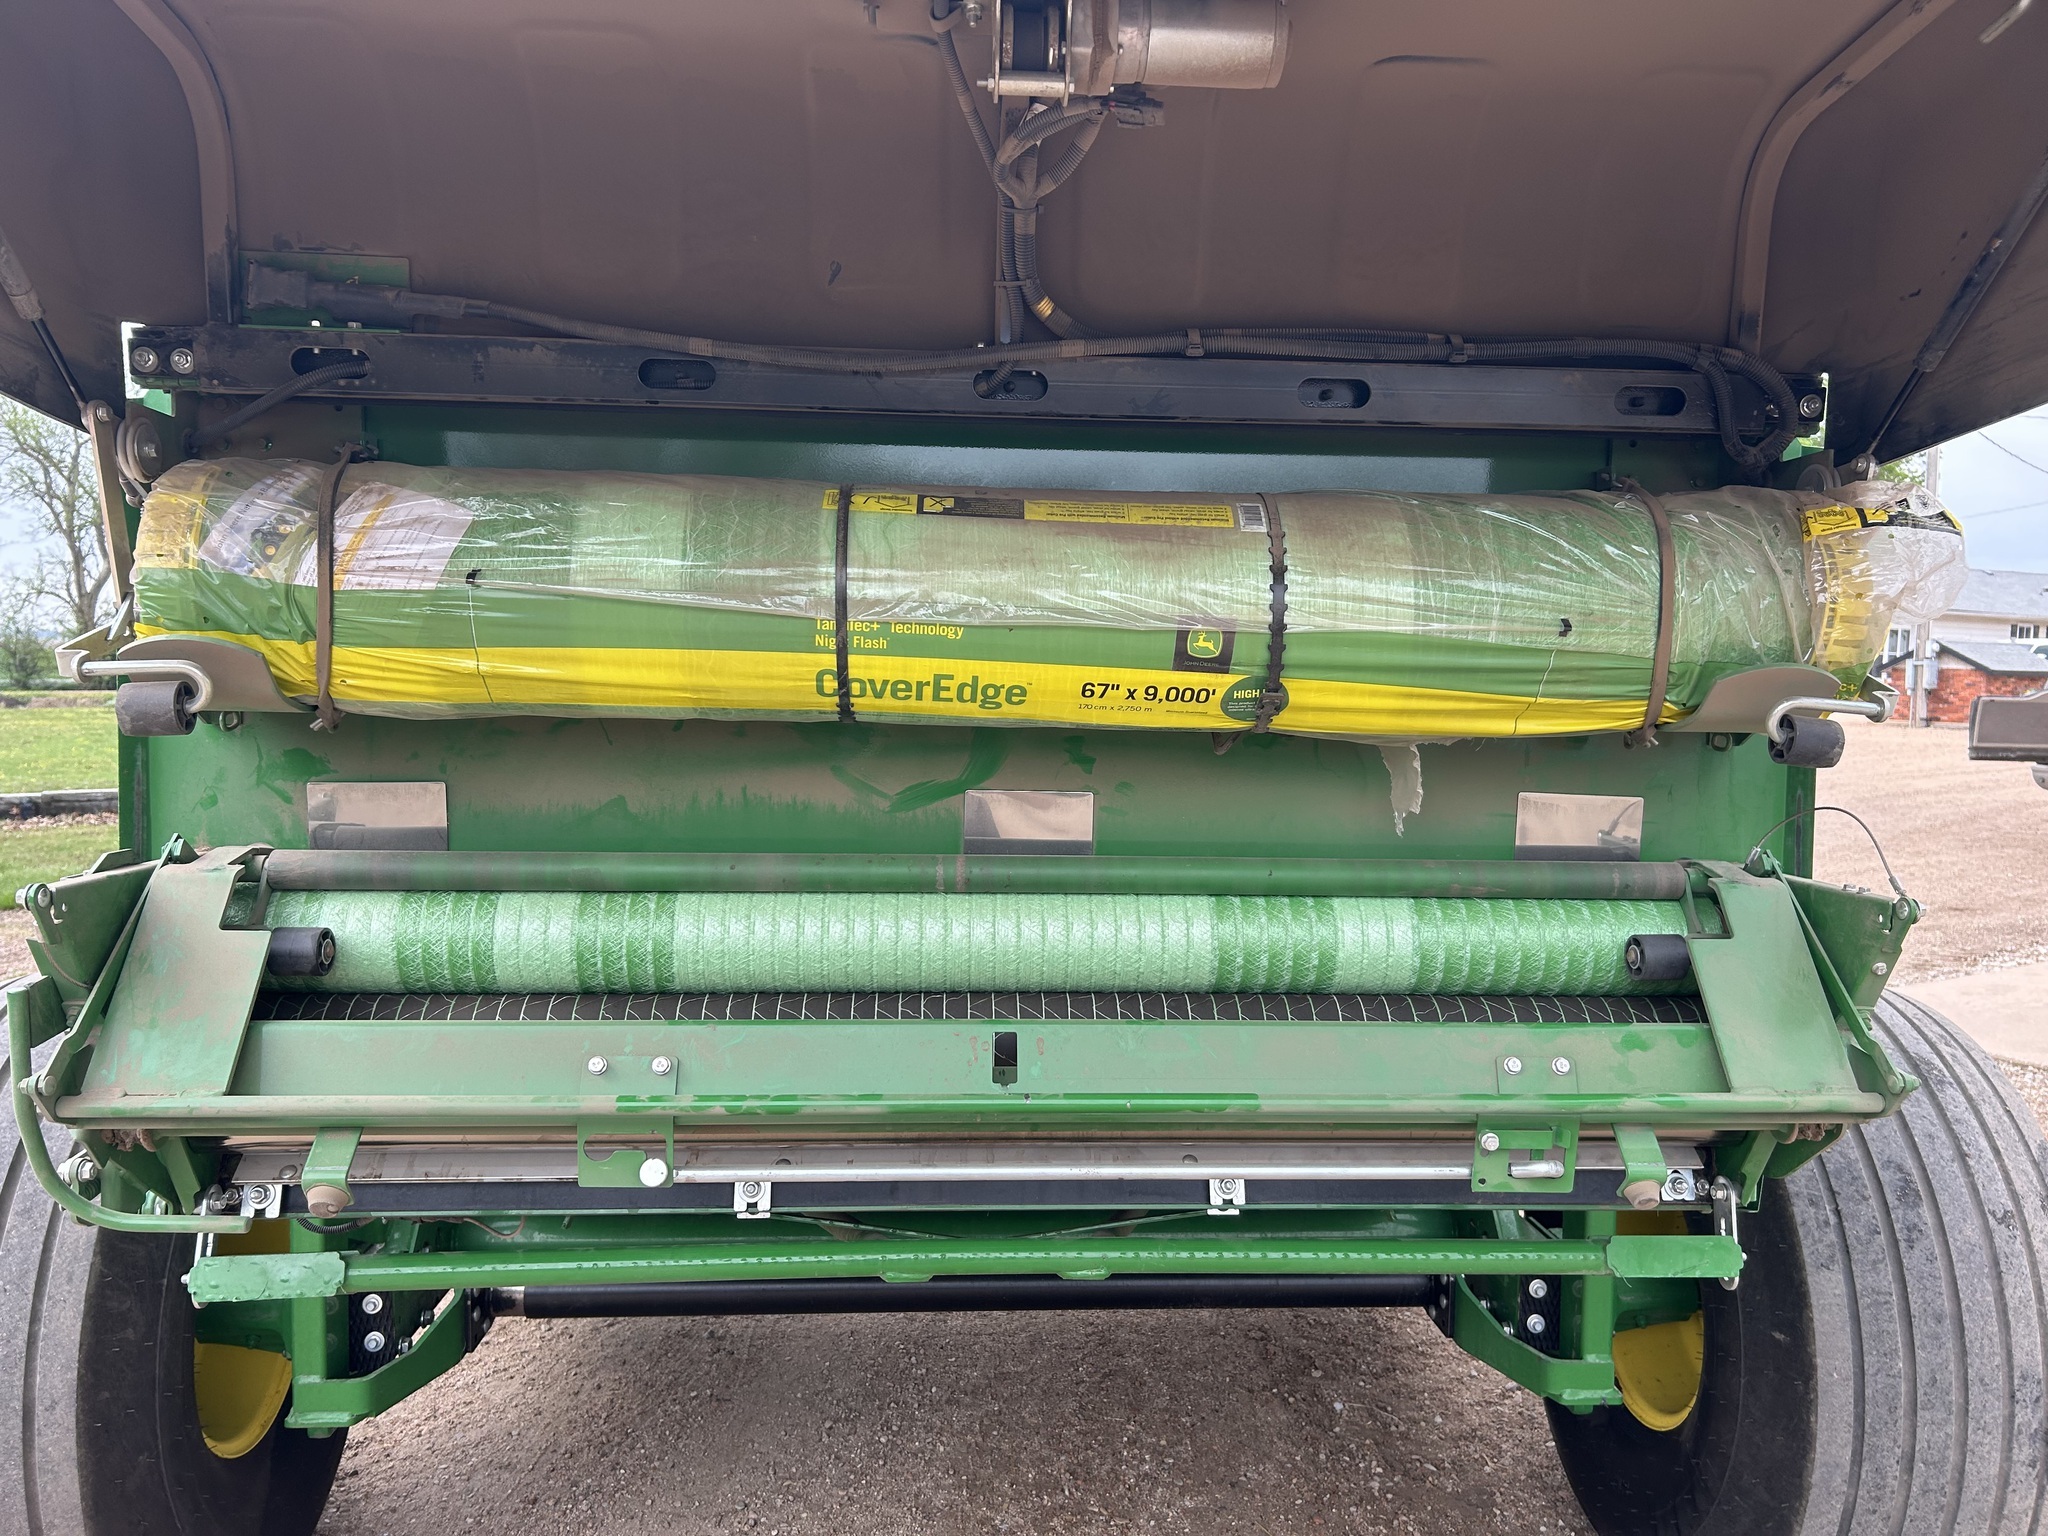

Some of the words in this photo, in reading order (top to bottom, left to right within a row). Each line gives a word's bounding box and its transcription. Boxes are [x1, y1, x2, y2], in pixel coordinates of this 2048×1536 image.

[815, 619, 880, 632] TaTec+
[889, 620, 964, 639] Technology
[815, 633, 849, 650] Nig
[853, 635, 888, 649] Flash
[1080, 682, 1120, 699] 67"
[1124, 688, 1138, 701] x
[1143, 685, 1217, 704] 9,000'
[1233, 688, 1260, 699] HIGH
